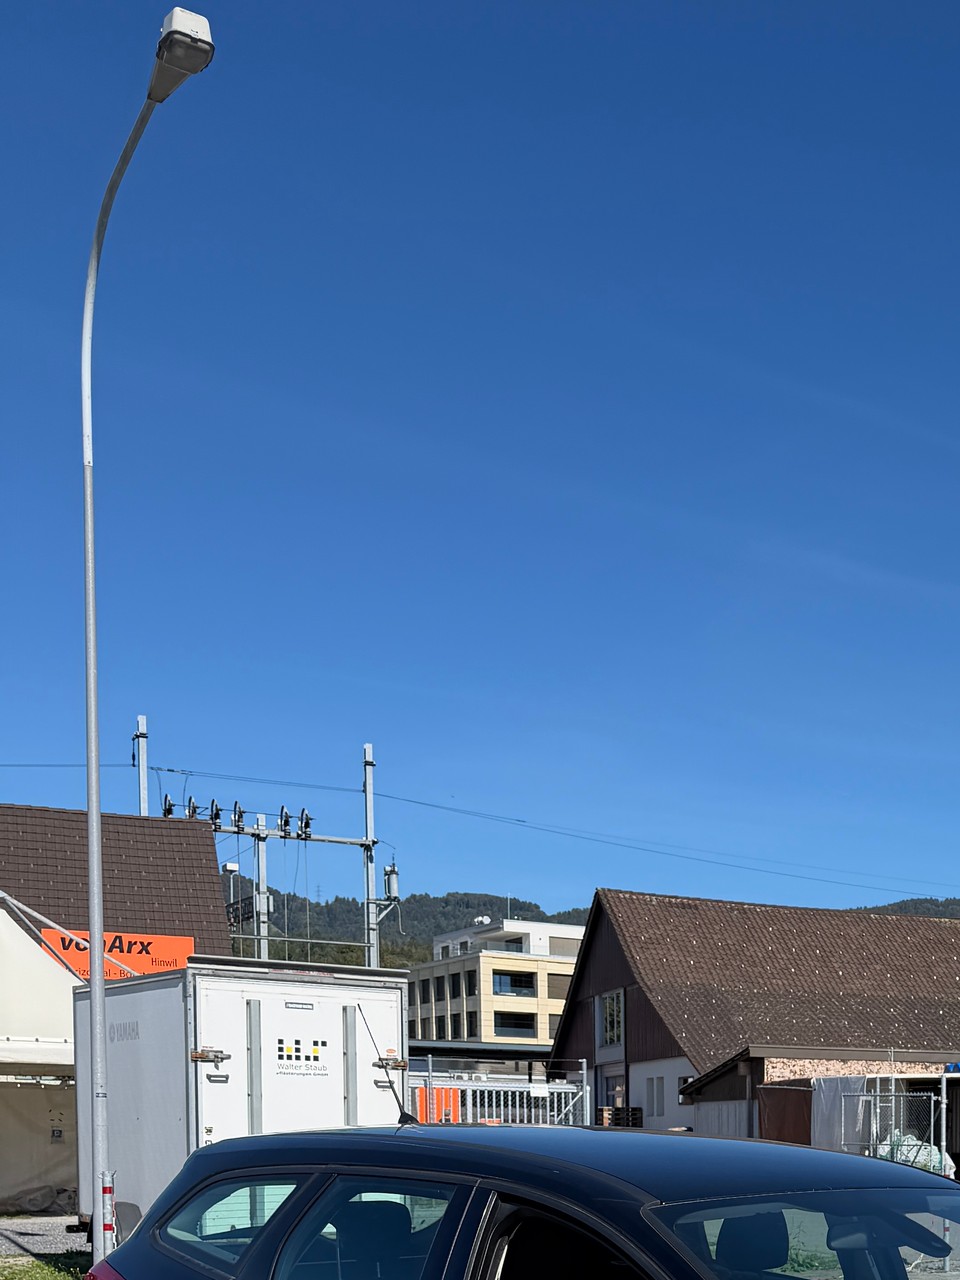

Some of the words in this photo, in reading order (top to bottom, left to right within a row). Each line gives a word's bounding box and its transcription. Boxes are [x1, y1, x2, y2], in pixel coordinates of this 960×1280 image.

[60, 935, 154, 955] voArx
[151, 957, 178, 967] Hinwil
[116, 1021, 140, 1041] YAMAHA
[277, 1063, 303, 1071] Walter
[305, 1064, 328, 1072] Staub
